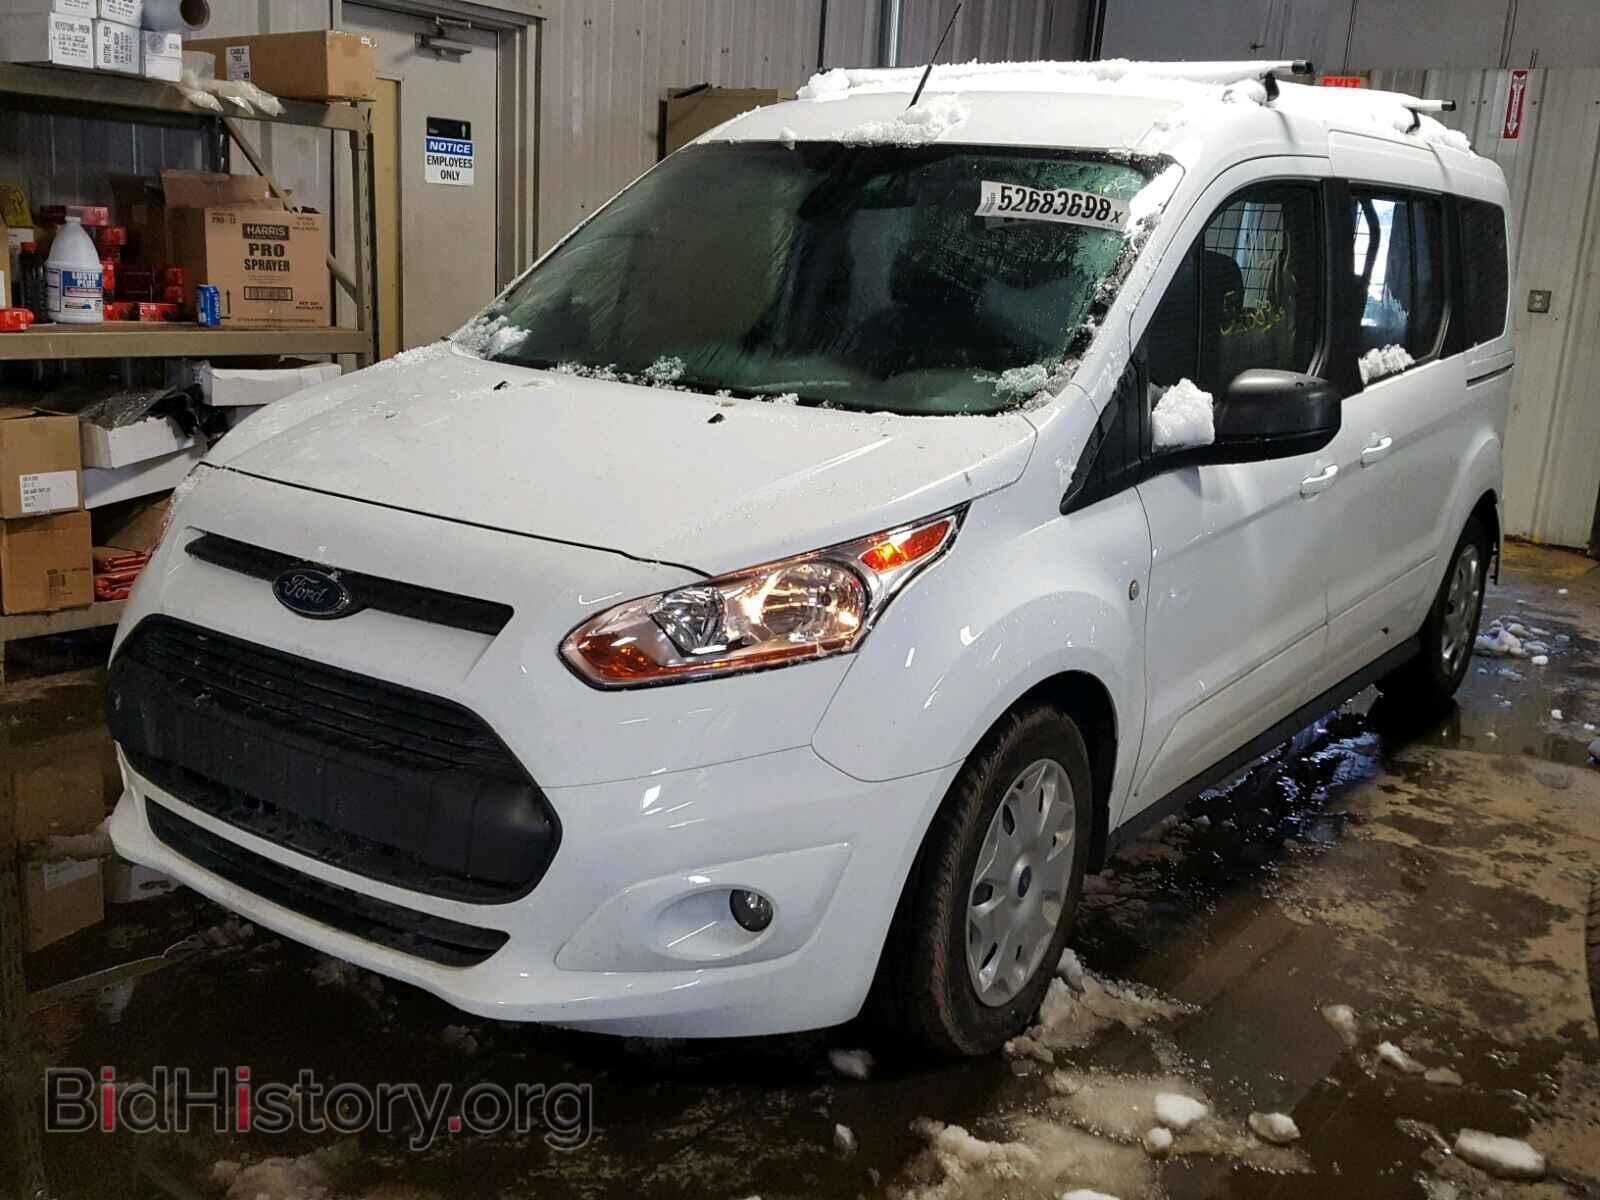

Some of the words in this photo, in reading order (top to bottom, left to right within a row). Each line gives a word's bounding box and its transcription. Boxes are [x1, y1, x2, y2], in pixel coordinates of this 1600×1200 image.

[429, 141, 471, 154] NOTICE
[426, 154, 473, 168] EMPLOYEES
[440, 169, 460, 181] ONLY
[997, 185, 1112, 222] 52683698
[246, 225, 287, 237] HARRIS
[248, 242, 285, 258] PRO
[244, 258, 291, 273] SPRAYER
[284, 574, 328, 604] Ford
